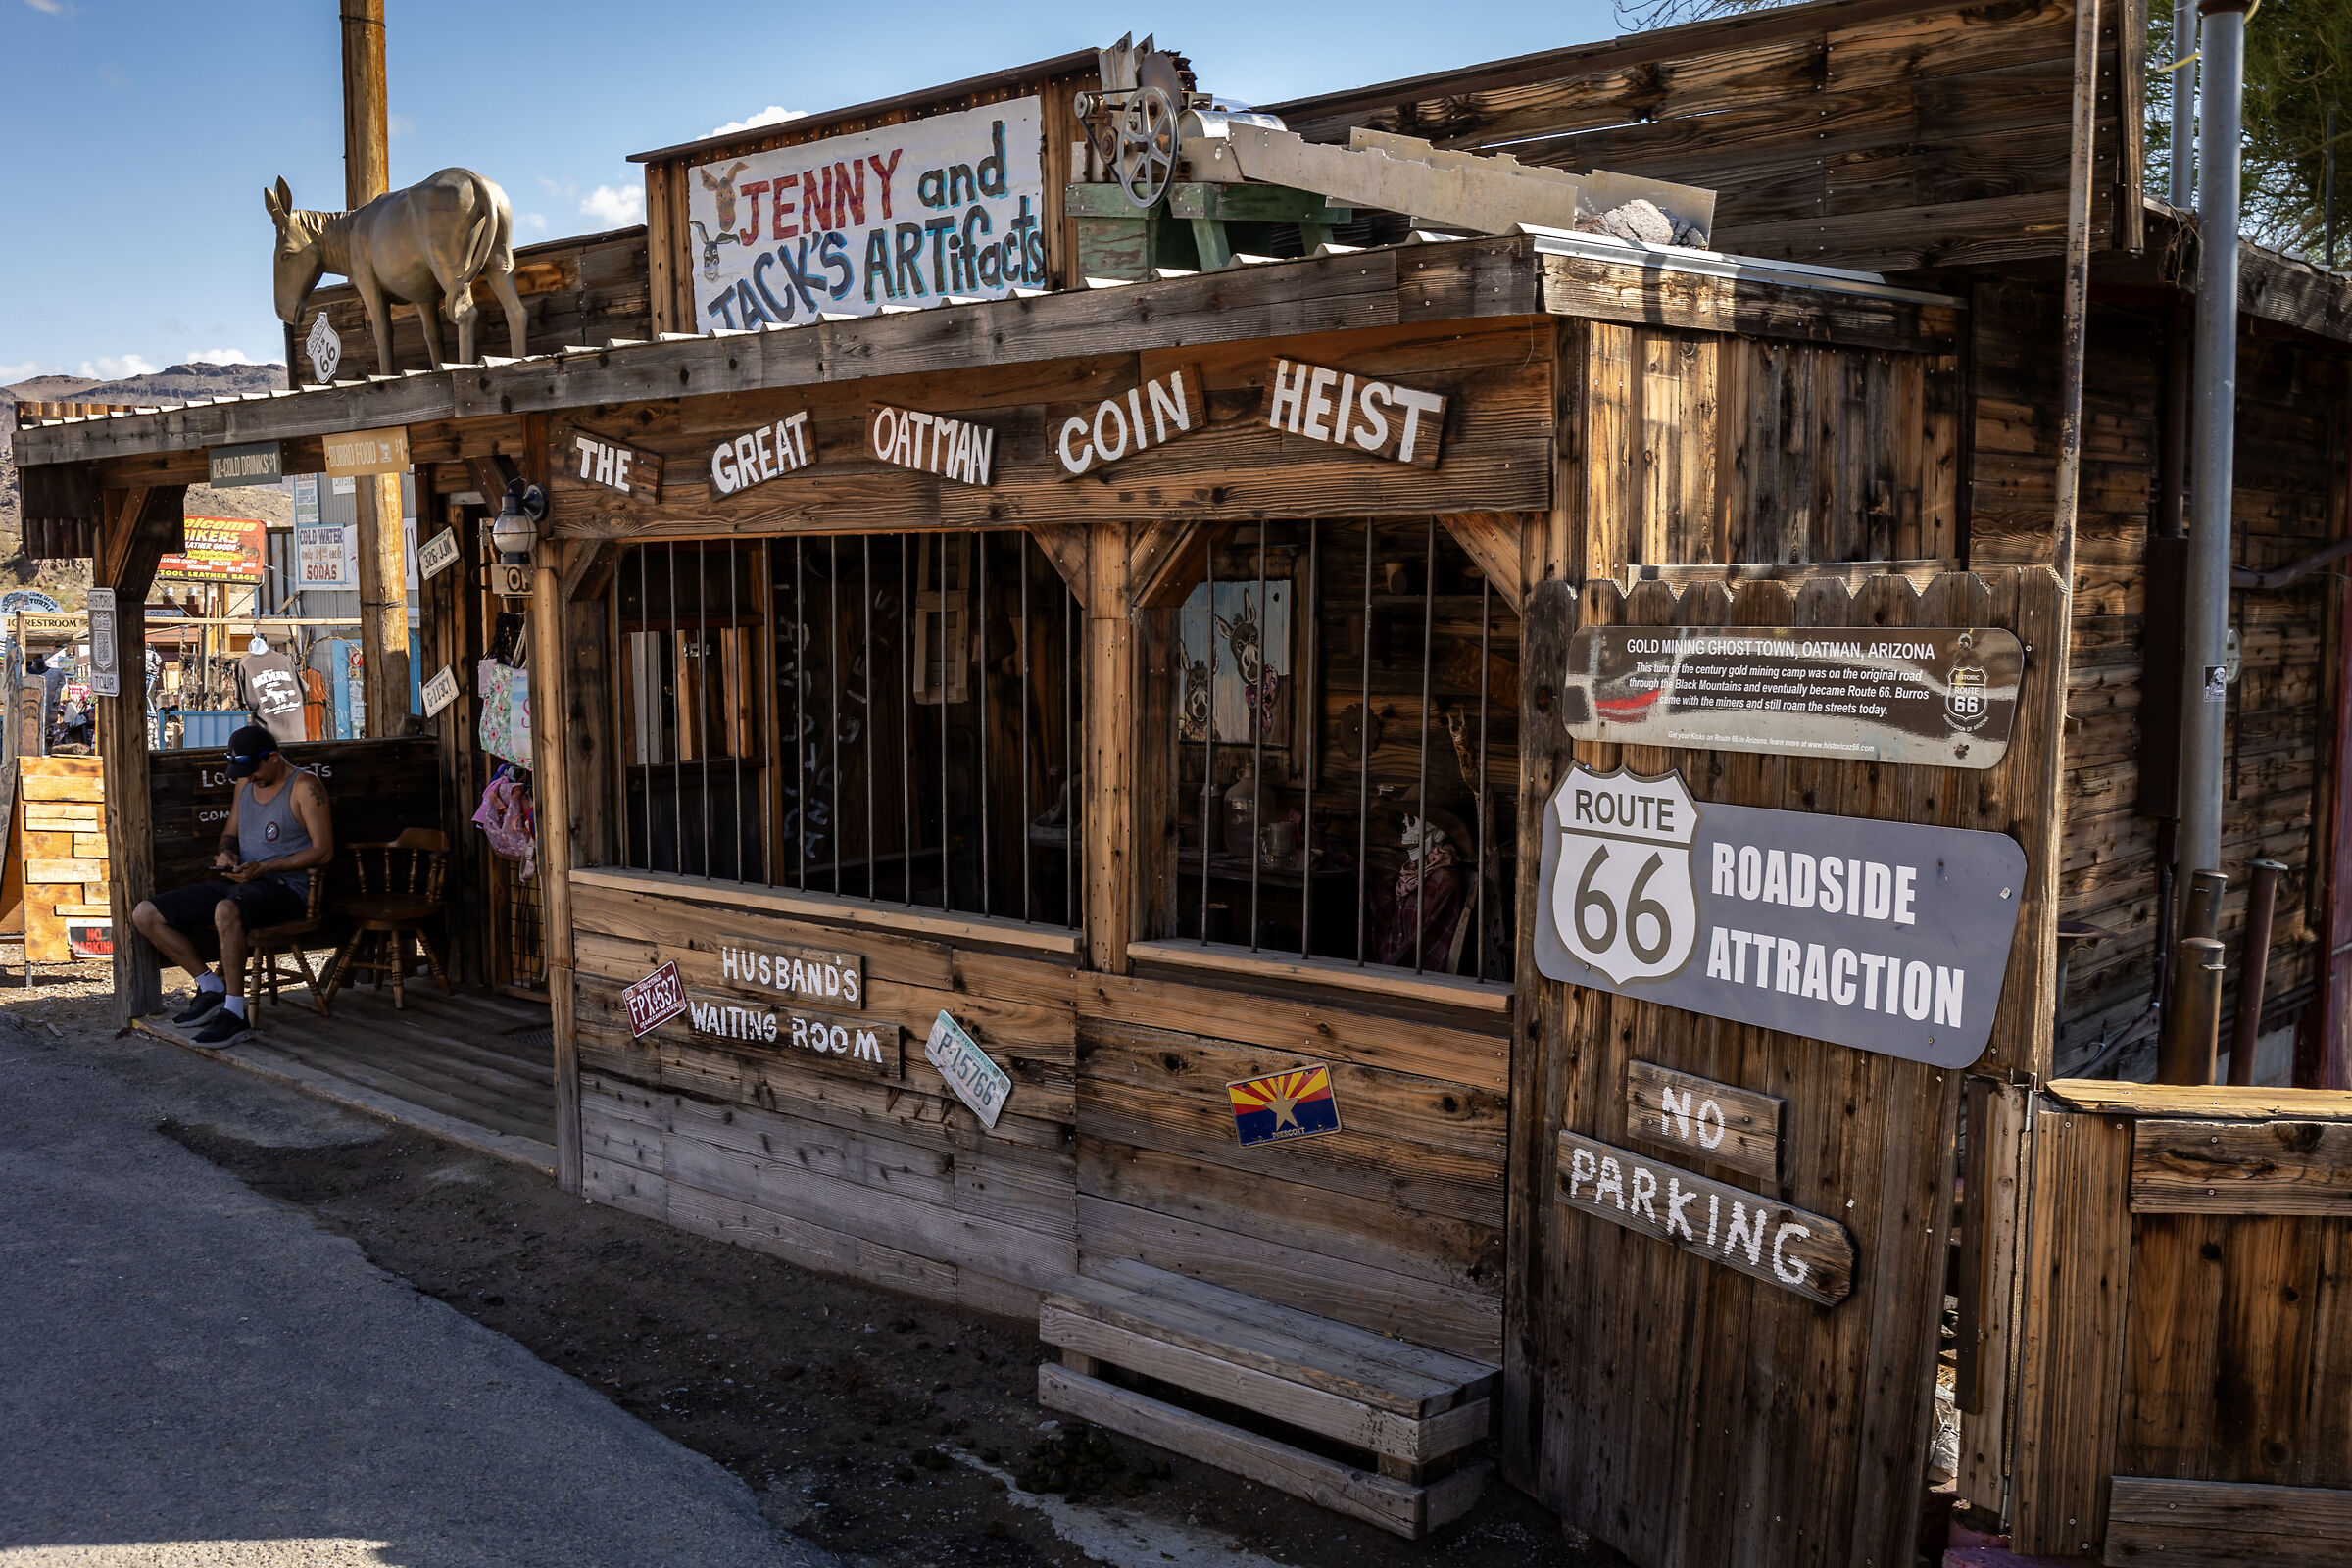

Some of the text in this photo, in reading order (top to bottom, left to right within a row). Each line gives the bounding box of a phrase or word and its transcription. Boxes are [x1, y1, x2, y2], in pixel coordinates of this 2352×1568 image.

[739, 120, 1008, 246] JENNY and
[319, 342, 336, 373] 66
[575, 359, 1443, 494] THE GREAT OATMAN COIN HEIST
[241, 453, 269, 476] DRINKS
[328, 443, 355, 467] BURRO
[355, 441, 376, 466] FOOD
[184, 517, 258, 532] elcome
[185, 541, 212, 550] EATHER
[299, 528, 343, 545] COLD WATER
[187, 570, 228, 579] LEATHER
[306, 564, 337, 580] SODAS
[25, 618, 77, 627] RESTROOM
[1627, 639, 1936, 661] GOLD MINING GHOST TOWN, OATMAN, ARIZONA
[94, 676, 115, 690] TOUR
[1636, 662, 1923, 682] This turn of the century gold mining camp was on the original road
[1629, 677, 1930, 700] through the Black Mountains and eventually became Route 66. Burros
[1954, 686, 1980, 695] ROUTE
[1659, 694, 1888, 717] came with the miners and still roam the streets today.
[1954, 695, 1979, 713] 66
[1575, 788, 1675, 833] ROUTE
[1711, 842, 1917, 925] ROADSIDE
[1574, 843, 1672, 965] 66
[86, 928, 102, 941] NO
[721, 946, 858, 1002] HUSBAND'S
[1706, 926, 1965, 1029] ATTRACTION
[689, 1000, 882, 1064] WAITING ROOM
[1661, 1086, 1725, 1150] NO
[1272, 1127, 1306, 1139] PRESCOTT
[1569, 1148, 1811, 1286] PARKING
